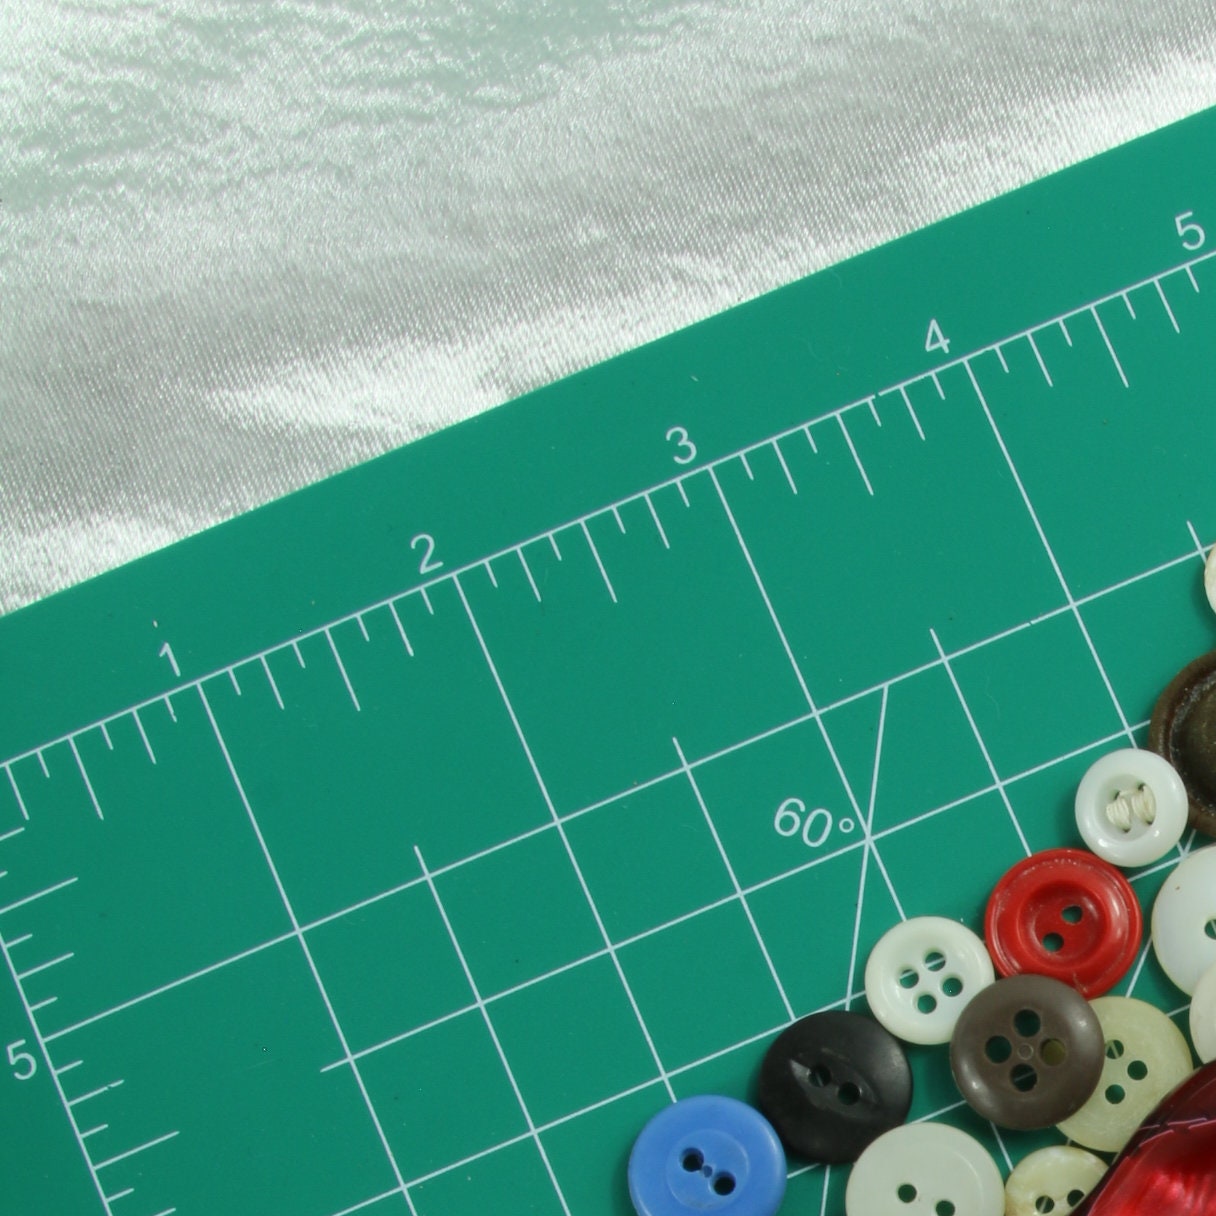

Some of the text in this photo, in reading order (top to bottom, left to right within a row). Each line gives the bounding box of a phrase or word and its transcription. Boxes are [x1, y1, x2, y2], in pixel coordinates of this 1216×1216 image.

[1174, 209, 1206, 251] 5
[924, 317, 951, 354] 4
[665, 425, 698, 465] 3
[409, 532, 444, 575] 2
[158, 641, 181, 677] 1
[5, 1038, 37, 1081] 5
